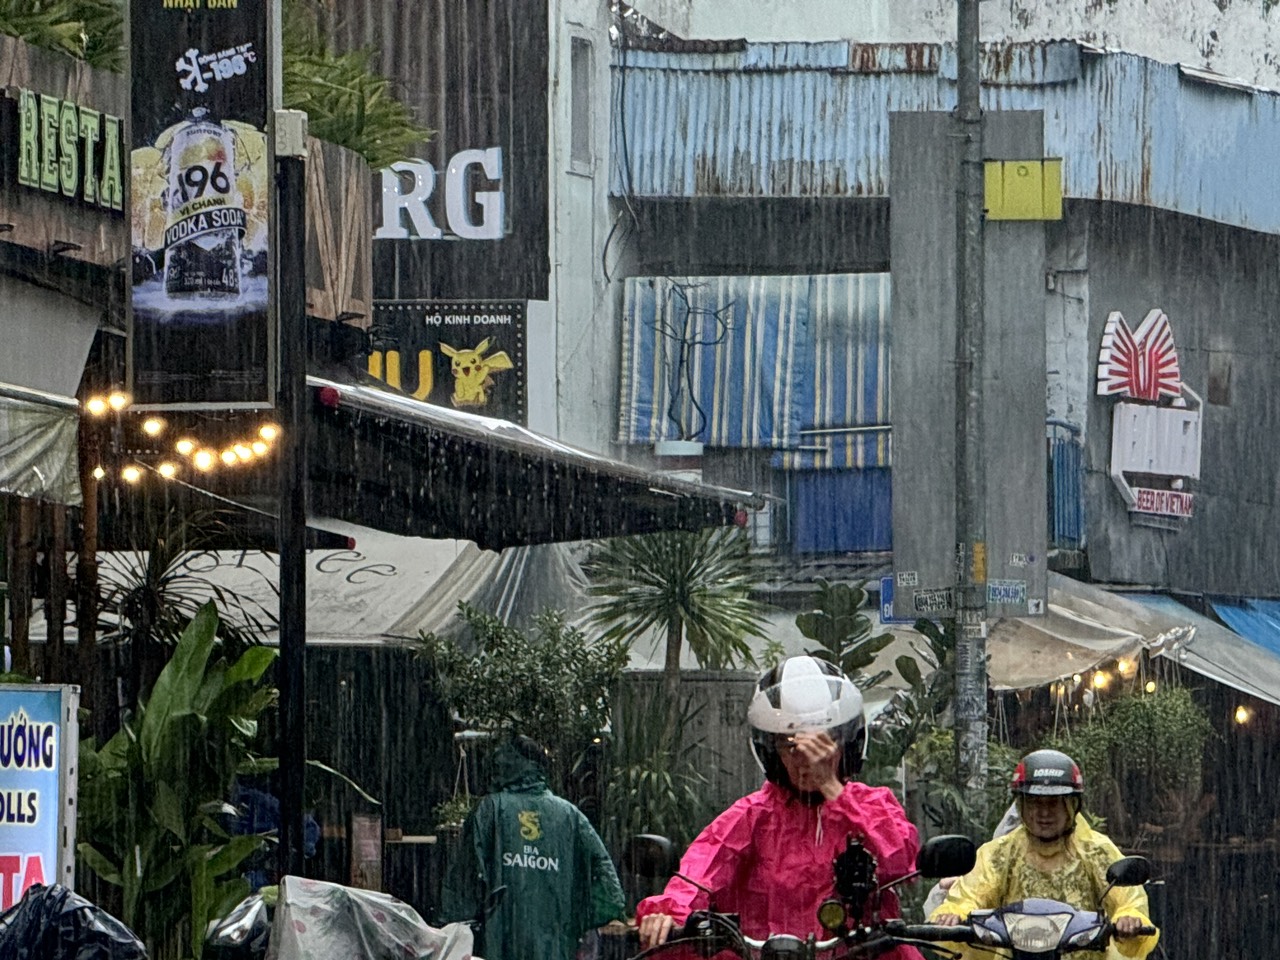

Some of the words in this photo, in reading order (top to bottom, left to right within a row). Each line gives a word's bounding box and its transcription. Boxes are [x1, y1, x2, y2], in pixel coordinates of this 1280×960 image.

[18, 87, 122, 210] RESTA
[178, 161, 230, 203] 196
[191, 197, 226, 210] CHANH
[166, 214, 208, 245] VODKA
[211, 208, 243, 227] SODA
[425, 312, 442, 328] HỘ
[444, 315, 471, 325] KINH
[473, 315, 512, 325] DOANH
[1137, 489, 1155, 511] BEER
[1156, 492, 1165, 512] OF
[1165, 493, 1193, 514] VIETNAM
[502, 852, 559, 871] SAIGON
[523, 845, 539, 856] BIA
